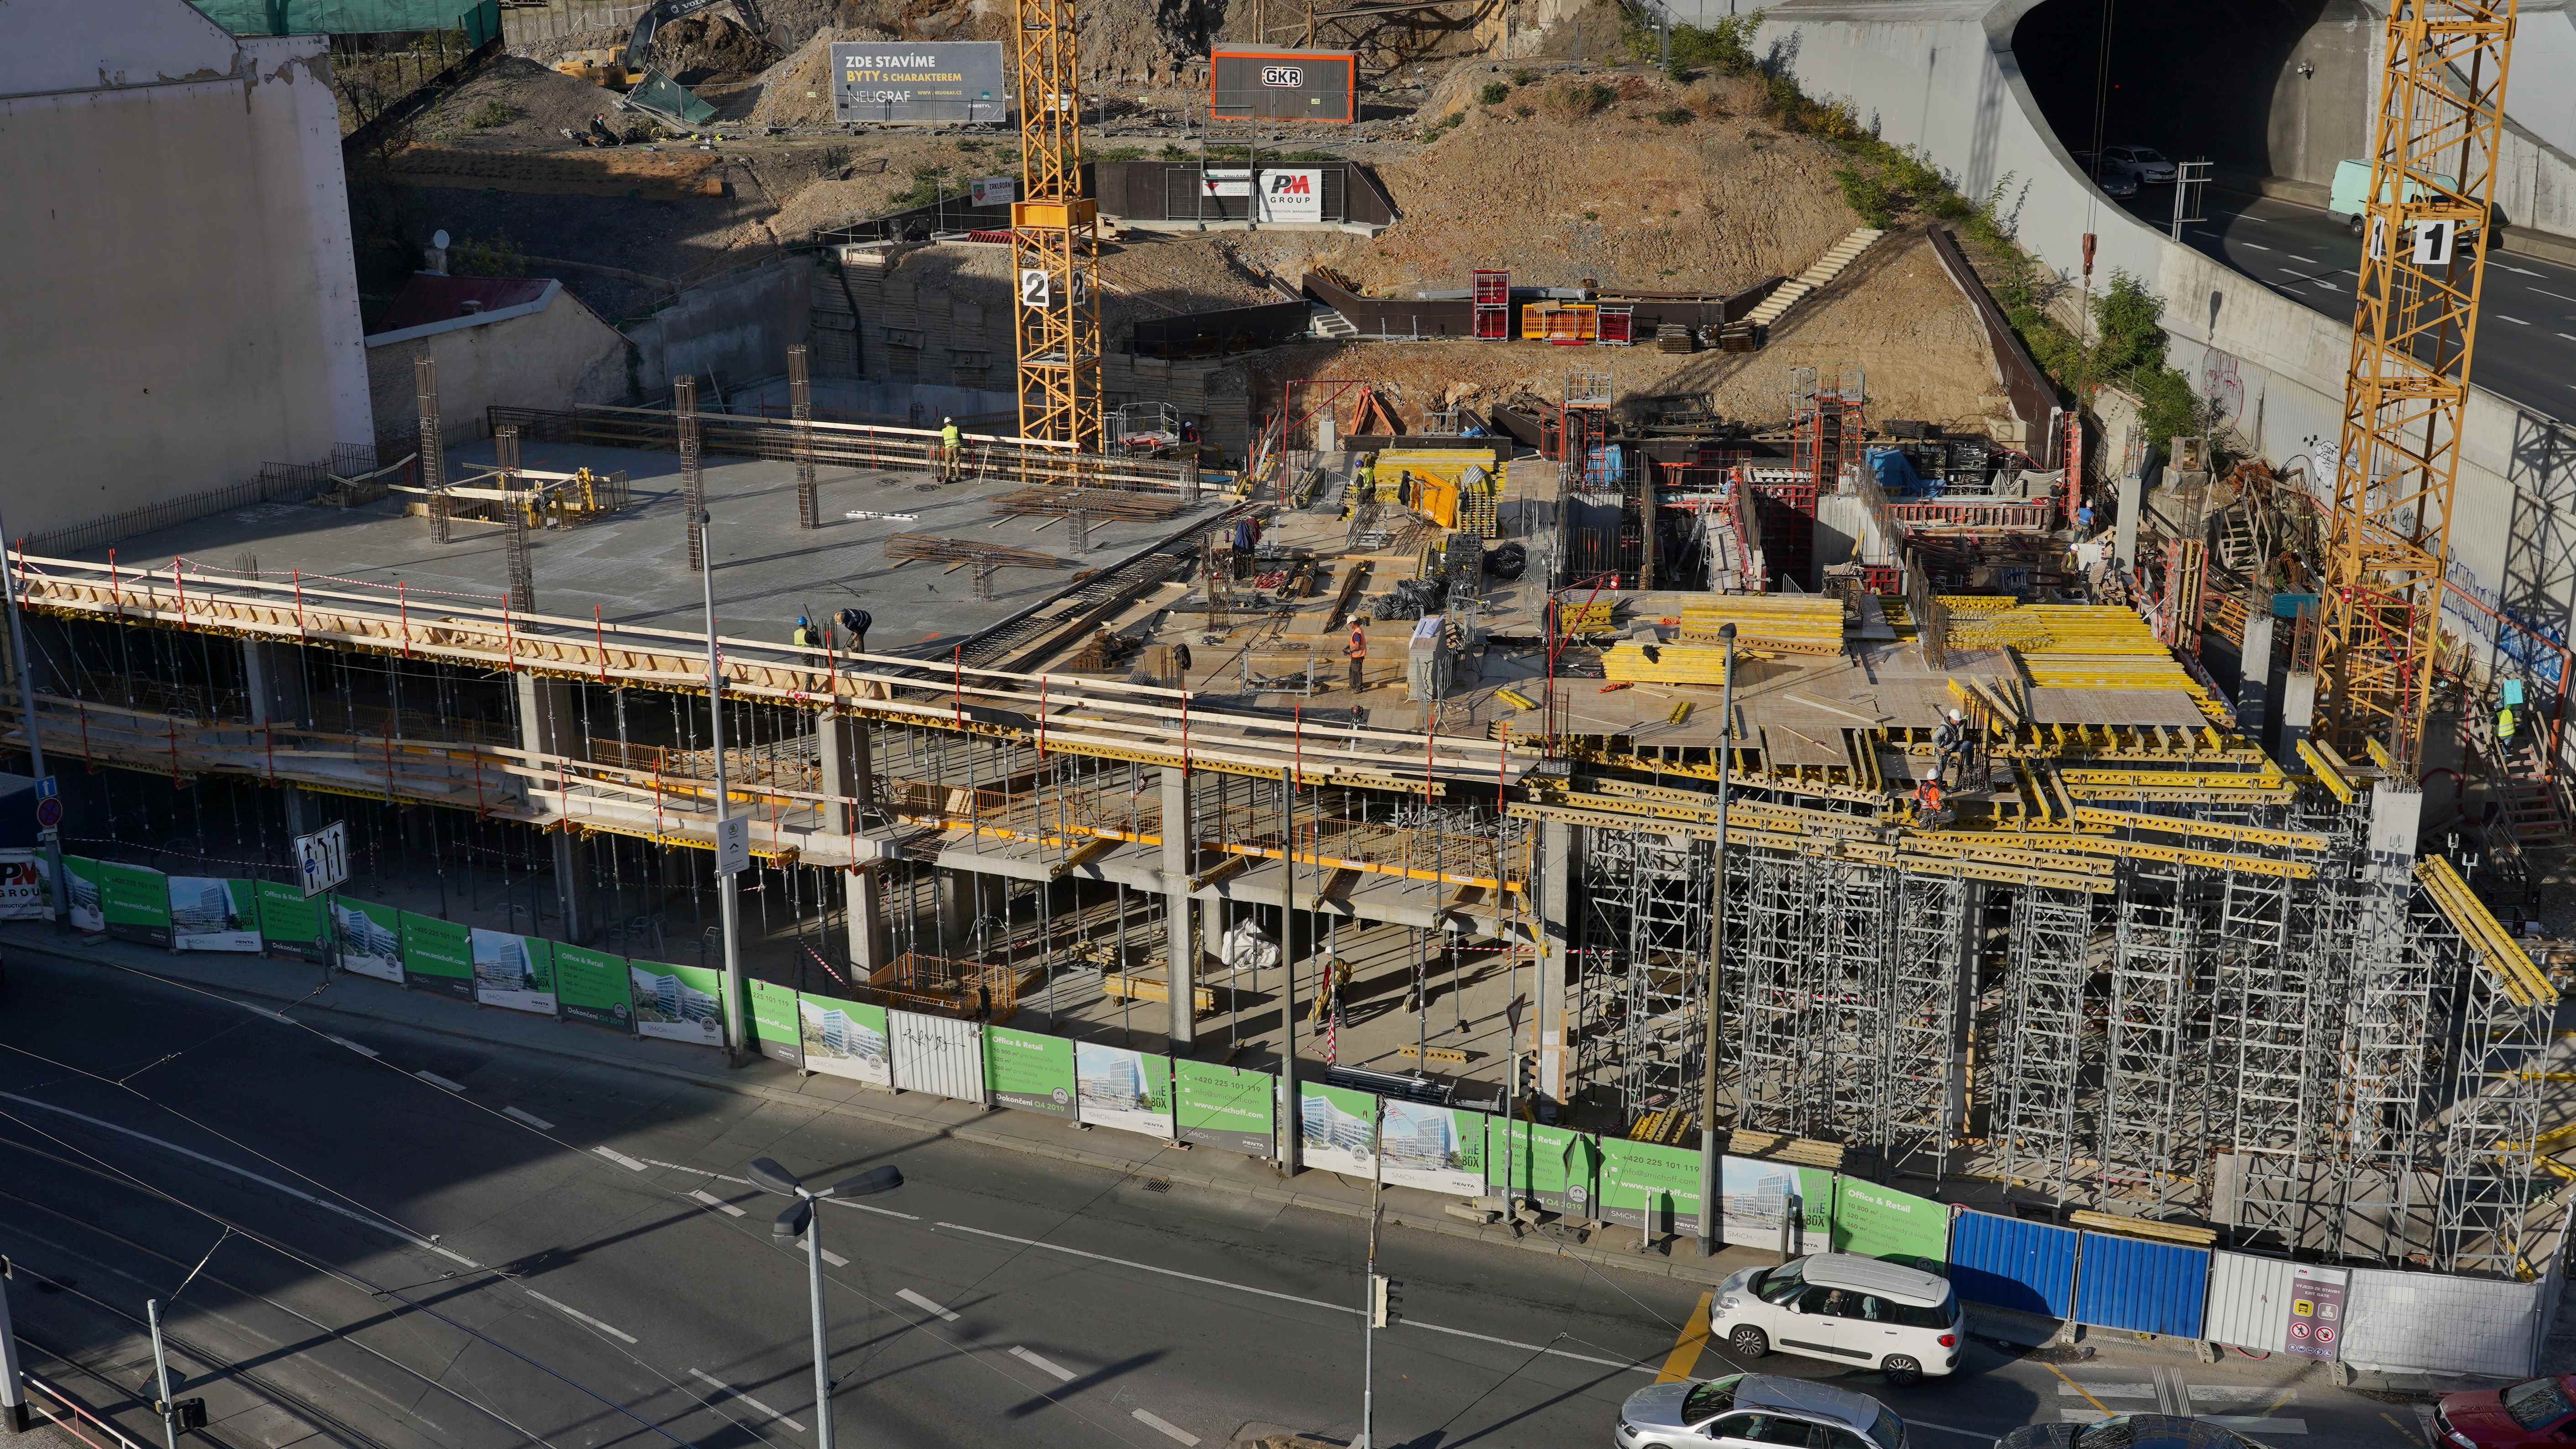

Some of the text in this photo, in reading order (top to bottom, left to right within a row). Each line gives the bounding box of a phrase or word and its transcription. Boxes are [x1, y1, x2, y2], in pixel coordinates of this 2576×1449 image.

[846, 52, 935, 68] ZDE STAVÍME
[846, 71, 961, 82] BYTY S CHARAKTEREM
[1266, 71, 1298, 83] GKR
[849, 90, 910, 103] NEUGRAF
[1271, 175, 1310, 194] PM
[2374, 220, 2382, 256] 1
[2424, 224, 2444, 260] 1
[1026, 273, 1045, 303] 2
[1073, 272, 1083, 303] 2
[114, 900, 163, 914] www.smichoff.com
[241, 917, 255, 927] BOX
[272, 942, 301, 953] Dokončení
[416, 949, 466, 966] www.smichoff.com
[562, 953, 579, 962] Office
[587, 959, 604, 968] Retail
[537, 977, 550, 988] BOX
[753, 992, 763, 1000] 225
[568, 1007, 598, 1020] Dokončení
[610, 1017, 624, 1025] 2019
[993, 1036, 1014, 1045] Office
[1023, 1041, 1043, 1051] Retail
[778, 1050, 795, 1058] PENTA
[1152, 1085, 1166, 1096] THE
[996, 1093, 1033, 1106] Dokončení
[1047, 1103, 1065, 1112] 2019
[1151, 1097, 1167, 1109] BOX
[1193, 1088, 1259, 1106] info@smichoff.com
[1194, 1102, 1264, 1119] www.smichoff.com
[1538, 1135, 1561, 1146] Retail
[1464, 1144, 1479, 1155] THE
[1463, 1156, 1479, 1168] BOX
[1535, 1157, 1560, 1167] obchody
[1623, 1155, 1644, 1163] +420
[1535, 1167, 1552, 1175] sklady
[1621, 1168, 1696, 1186] info@smichoff.com
[1621, 1182, 1700, 1200] www.smichoff.com
[1547, 1198, 1559, 1207] Q4
[1848, 1190, 1911, 1213] Office & Retail
[1808, 1202, 1825, 1214] THE
[1807, 1215, 1825, 1227] BOX
[1880, 1231, 1899, 1242] sklady
[1881, 1222, 1908, 1235] obchody
[1914, 1233, 1934, 1243] služby
